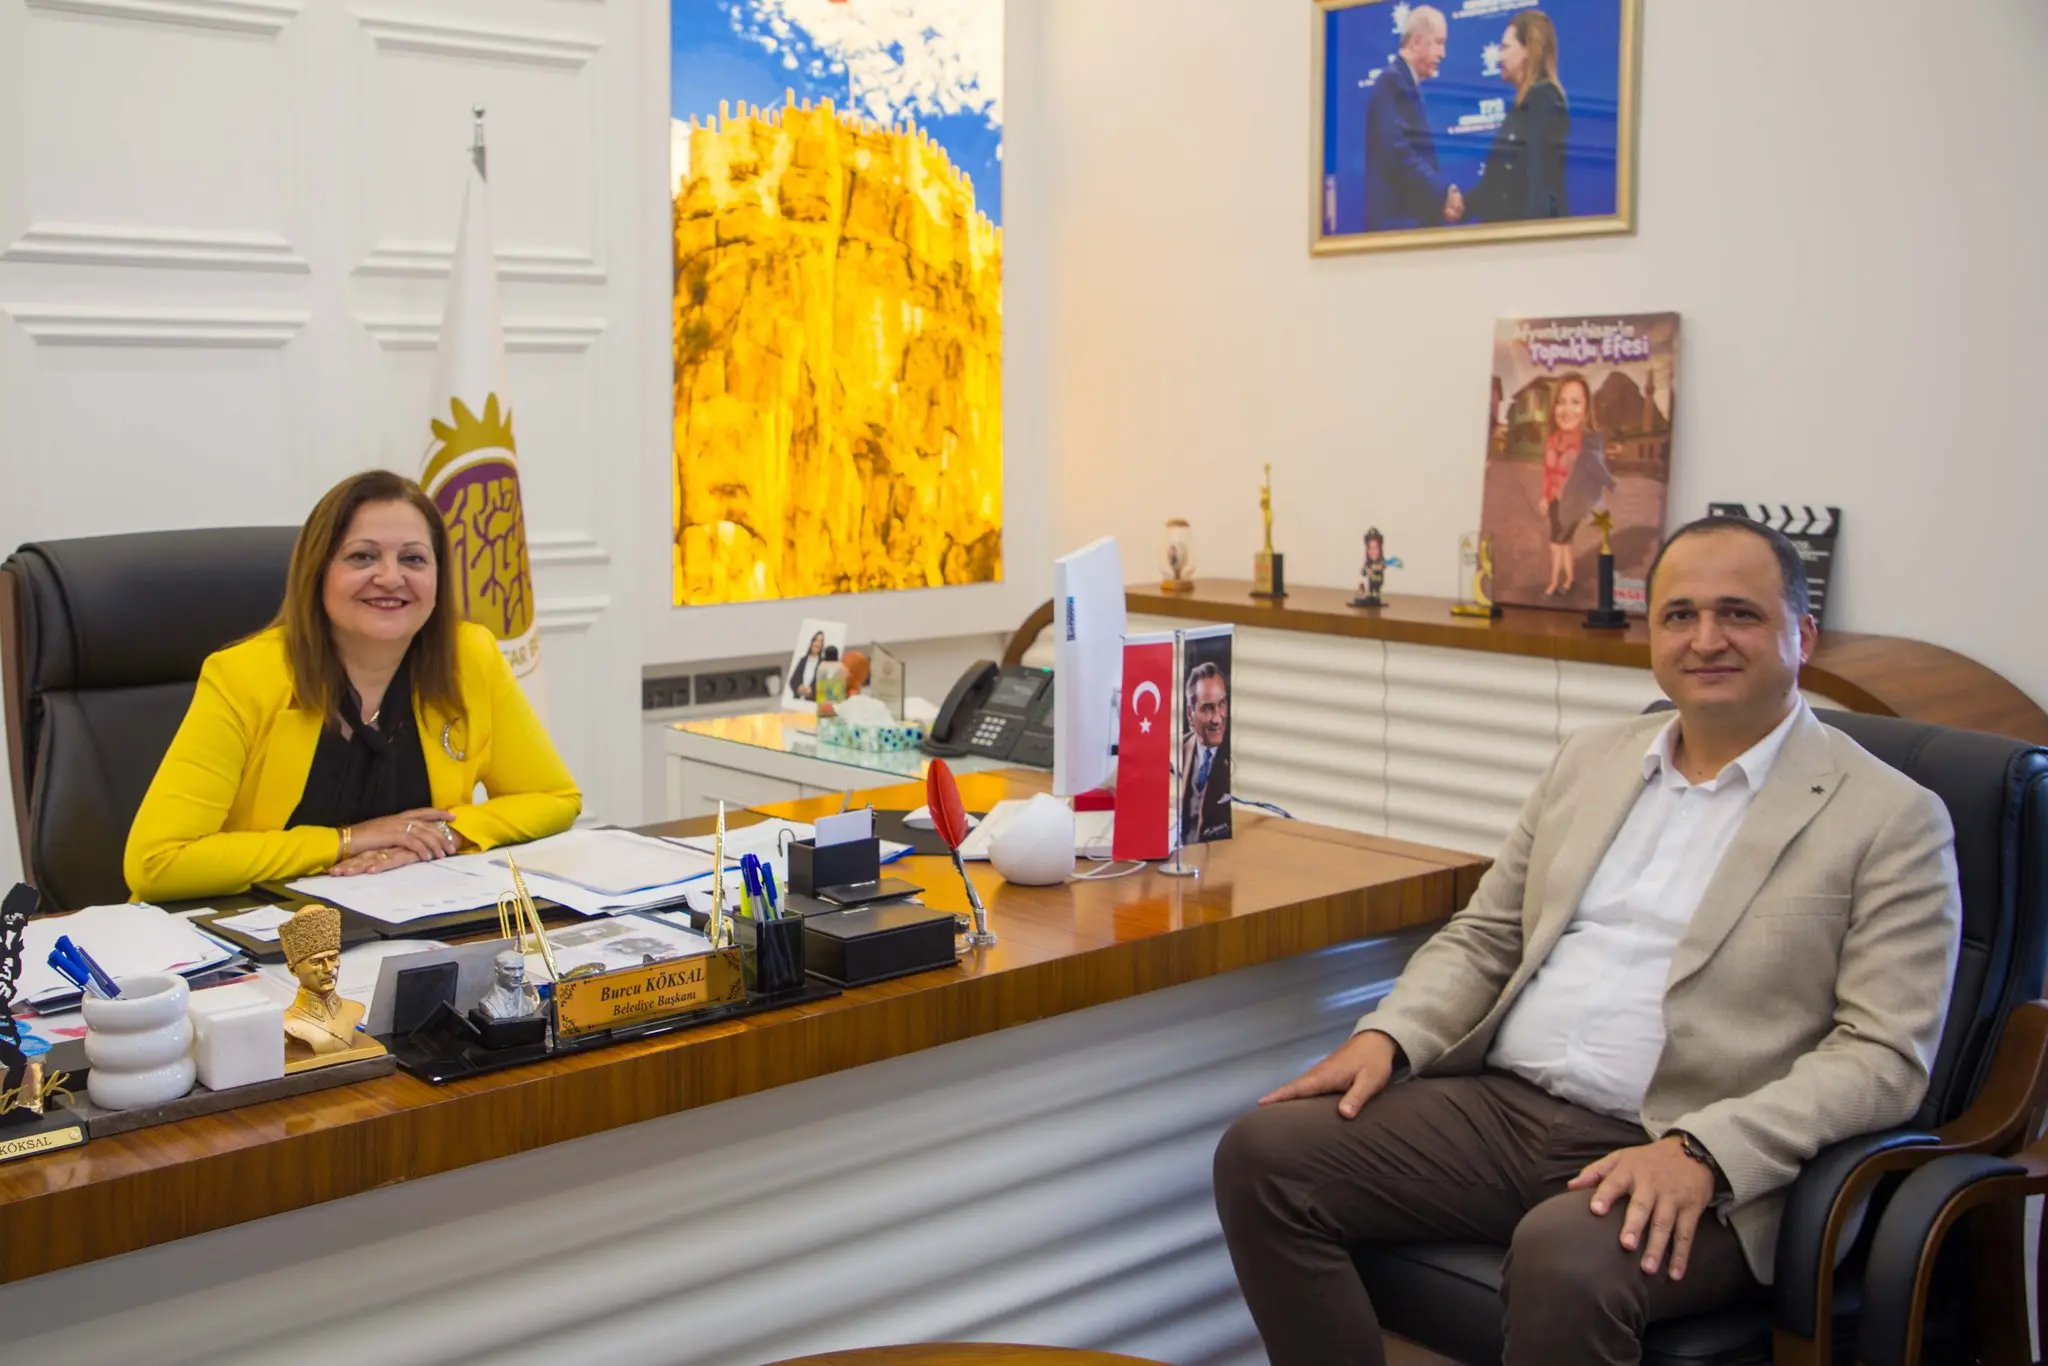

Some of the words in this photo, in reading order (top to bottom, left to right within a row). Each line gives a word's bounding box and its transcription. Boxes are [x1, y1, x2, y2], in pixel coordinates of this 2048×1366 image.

[1600, 334, 1649, 362] Efesi
[600, 984, 642, 1001] Burcu
[645, 967, 705, 992] KÖKSAL
[613, 999, 655, 1016] Belediye
[657, 991, 697, 1007] Başkanı
